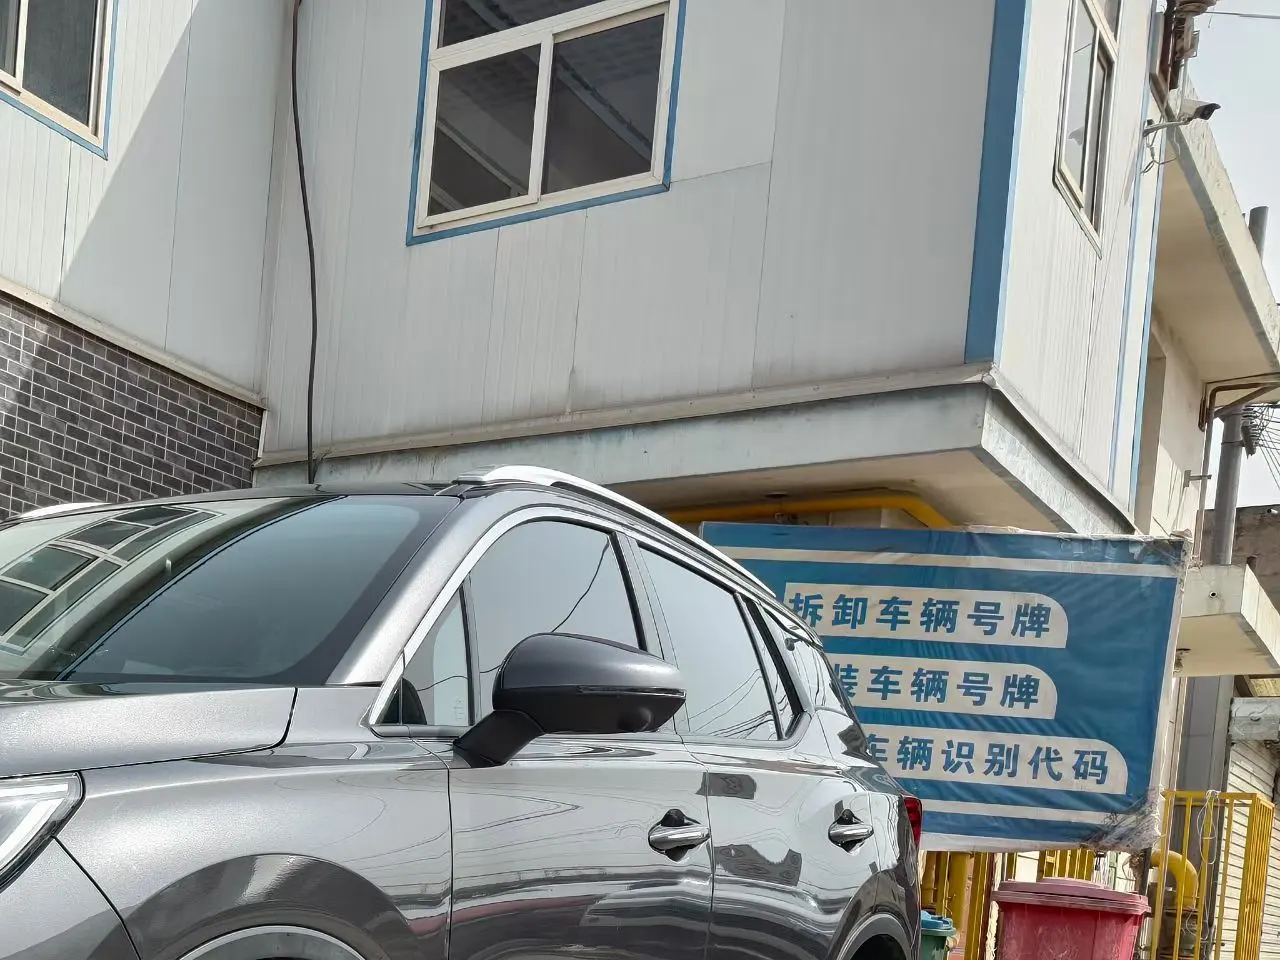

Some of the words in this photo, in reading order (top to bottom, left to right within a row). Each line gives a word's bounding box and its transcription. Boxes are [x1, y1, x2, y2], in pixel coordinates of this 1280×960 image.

[788, 592, 1052, 639] 拆卸车辆号牌
